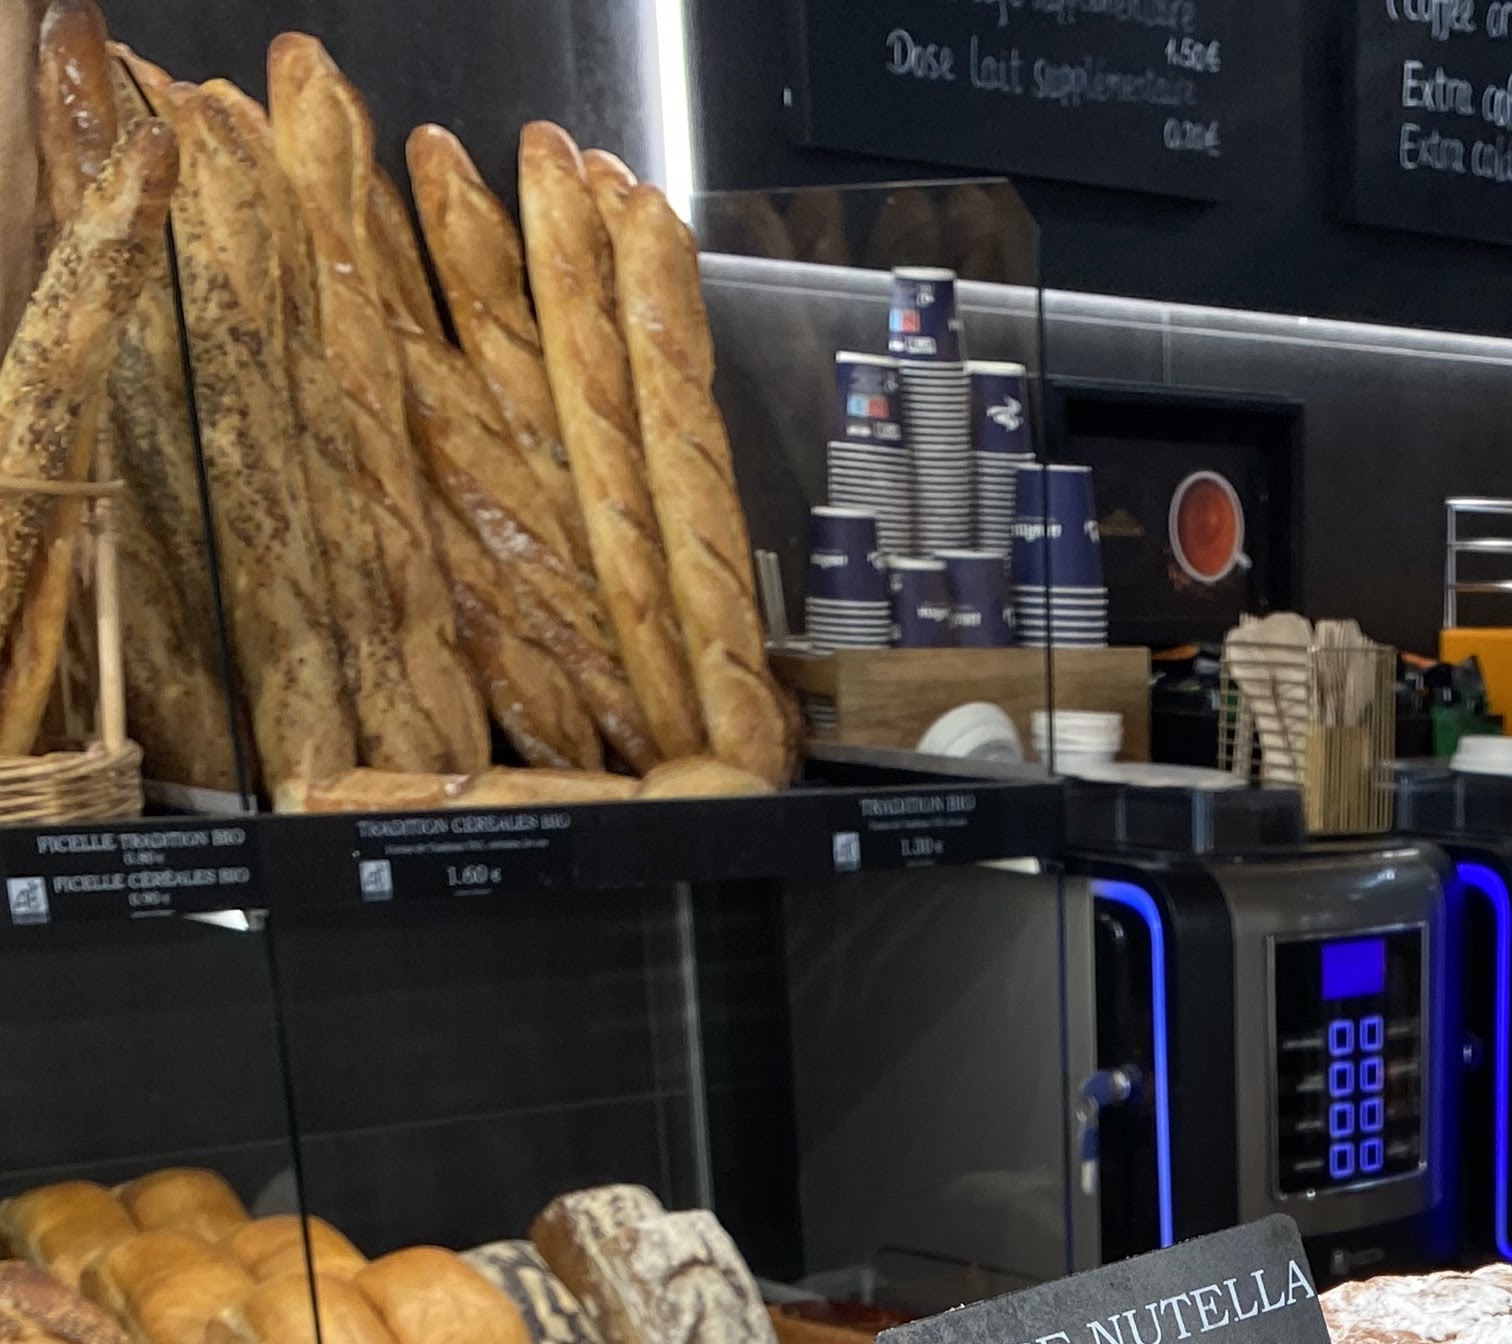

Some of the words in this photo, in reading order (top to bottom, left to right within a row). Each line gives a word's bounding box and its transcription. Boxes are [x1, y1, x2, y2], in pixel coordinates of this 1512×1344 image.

[886, 28, 956, 81] Dose
[1402, 59, 1475, 116] Extra
[1400, 122, 1466, 174] Extra
